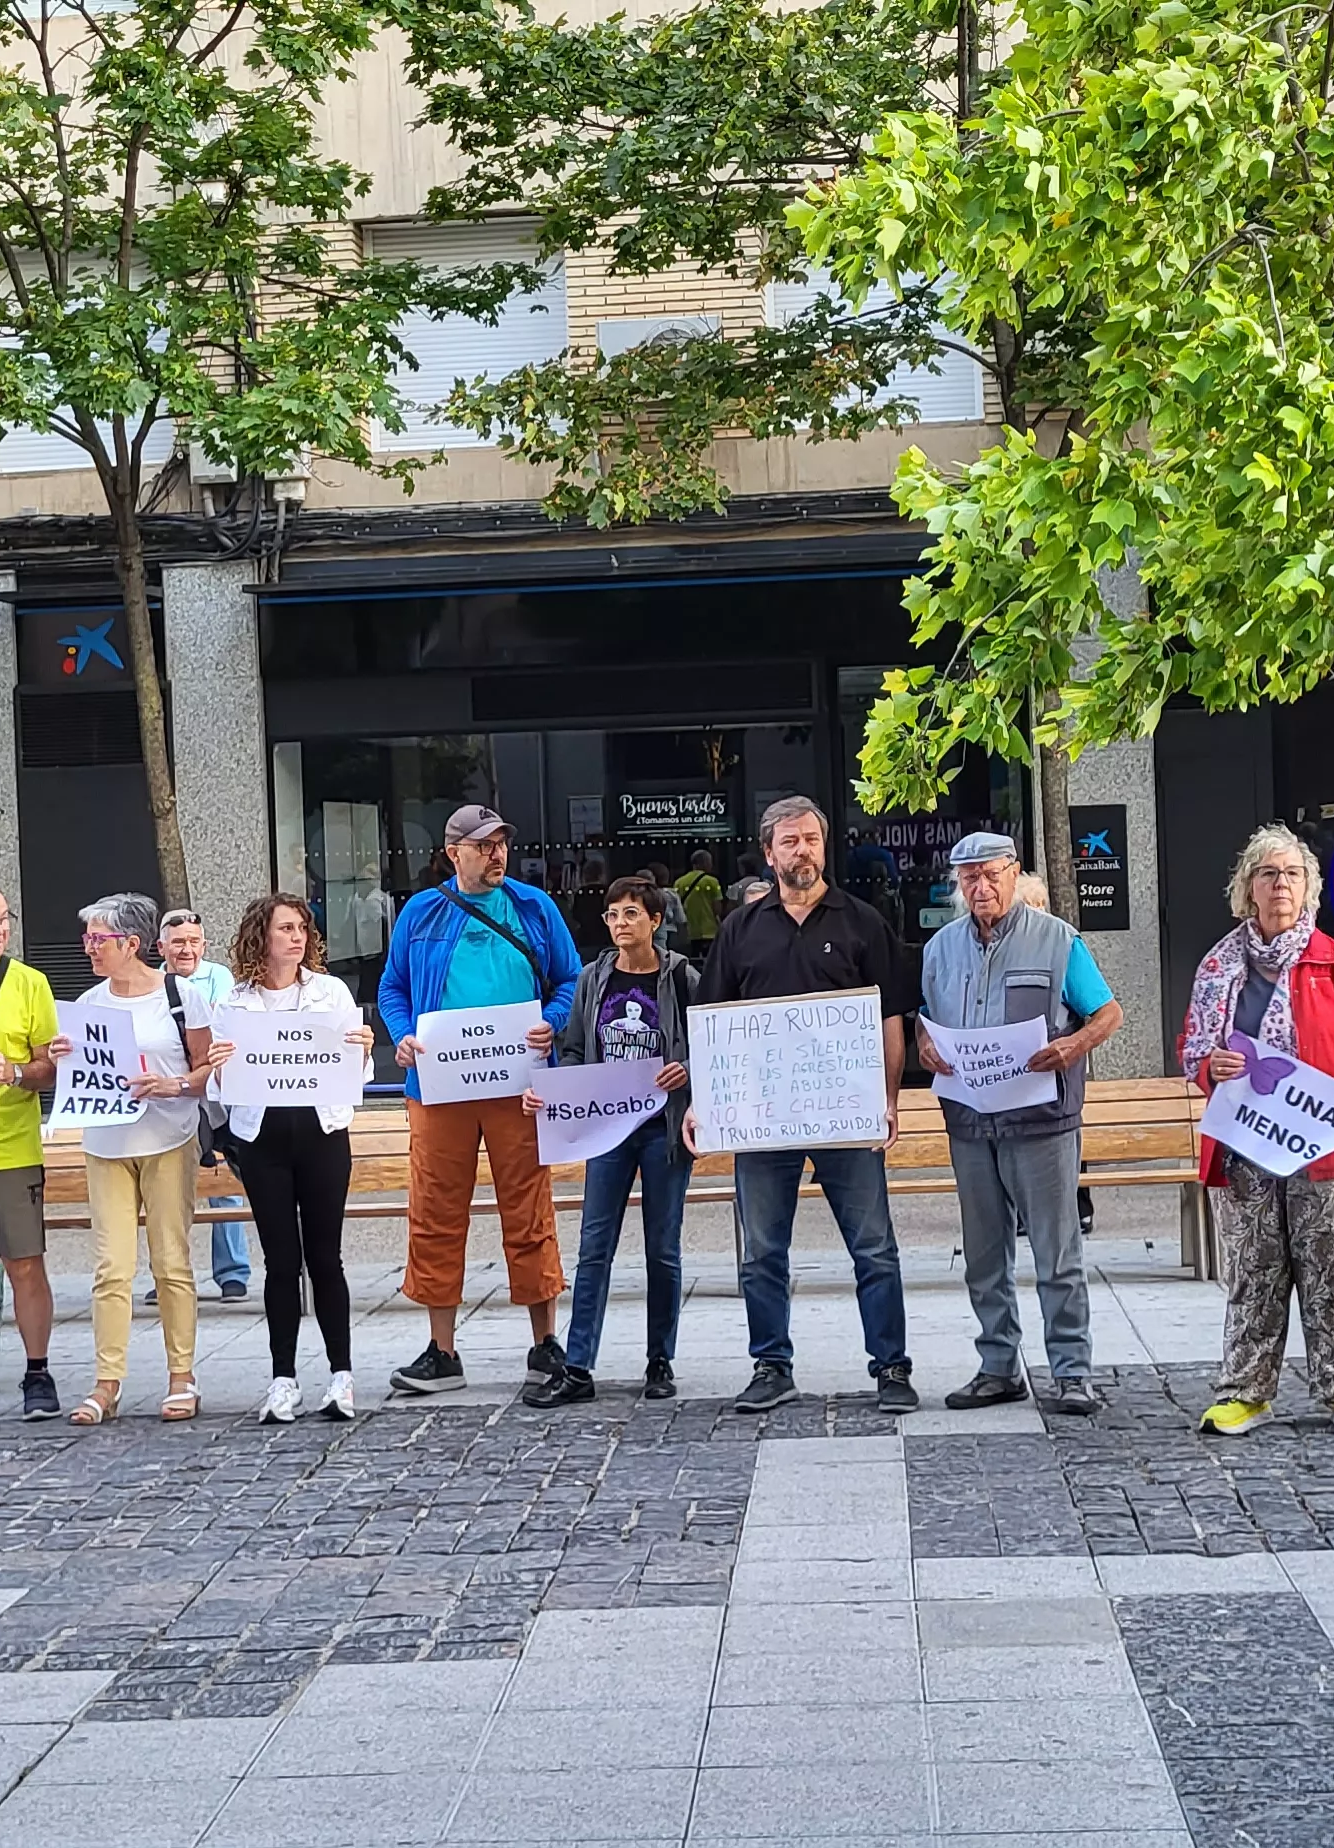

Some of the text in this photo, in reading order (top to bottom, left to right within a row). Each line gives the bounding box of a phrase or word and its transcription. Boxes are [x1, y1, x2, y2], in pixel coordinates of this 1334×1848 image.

[619, 793, 726, 818] Buenas tardes
[1079, 884, 1115, 896] Store
[1082, 898, 1113, 907] Huesca
[85, 1022, 108, 1044] NI
[277, 1030, 313, 1042] NOS
[461, 1024, 496, 1039] NOS
[83, 1046, 115, 1068] UN
[246, 1052, 342, 1066] QUEREMOS
[437, 1042, 527, 1064] QUEREMOS
[954, 1042, 1002, 1056] VIVAS
[709, 1053, 751, 1072] ANTE
[962, 1054, 1015, 1072] LIBRES
[71, 1069, 131, 1092] PASO
[267, 1077, 318, 1090] VIVAS
[461, 1069, 510, 1085] VIVAS
[711, 1073, 748, 1092] ANTE
[759, 1067, 782, 1081] LAS
[964, 1062, 1033, 1090] QUEREMO
[713, 1090, 748, 1106] ANTE
[790, 1077, 847, 1094] ABUSO
[60, 1094, 141, 1115] ATRÁS
[546, 1092, 656, 1122] #SeAcabó
[709, 1094, 861, 1126] NO TE CALLES
[781, 1122, 821, 1137] RUIDO
[829, 1114, 881, 1132] RUIDO!
[1234, 1104, 1321, 1160] MENOS
